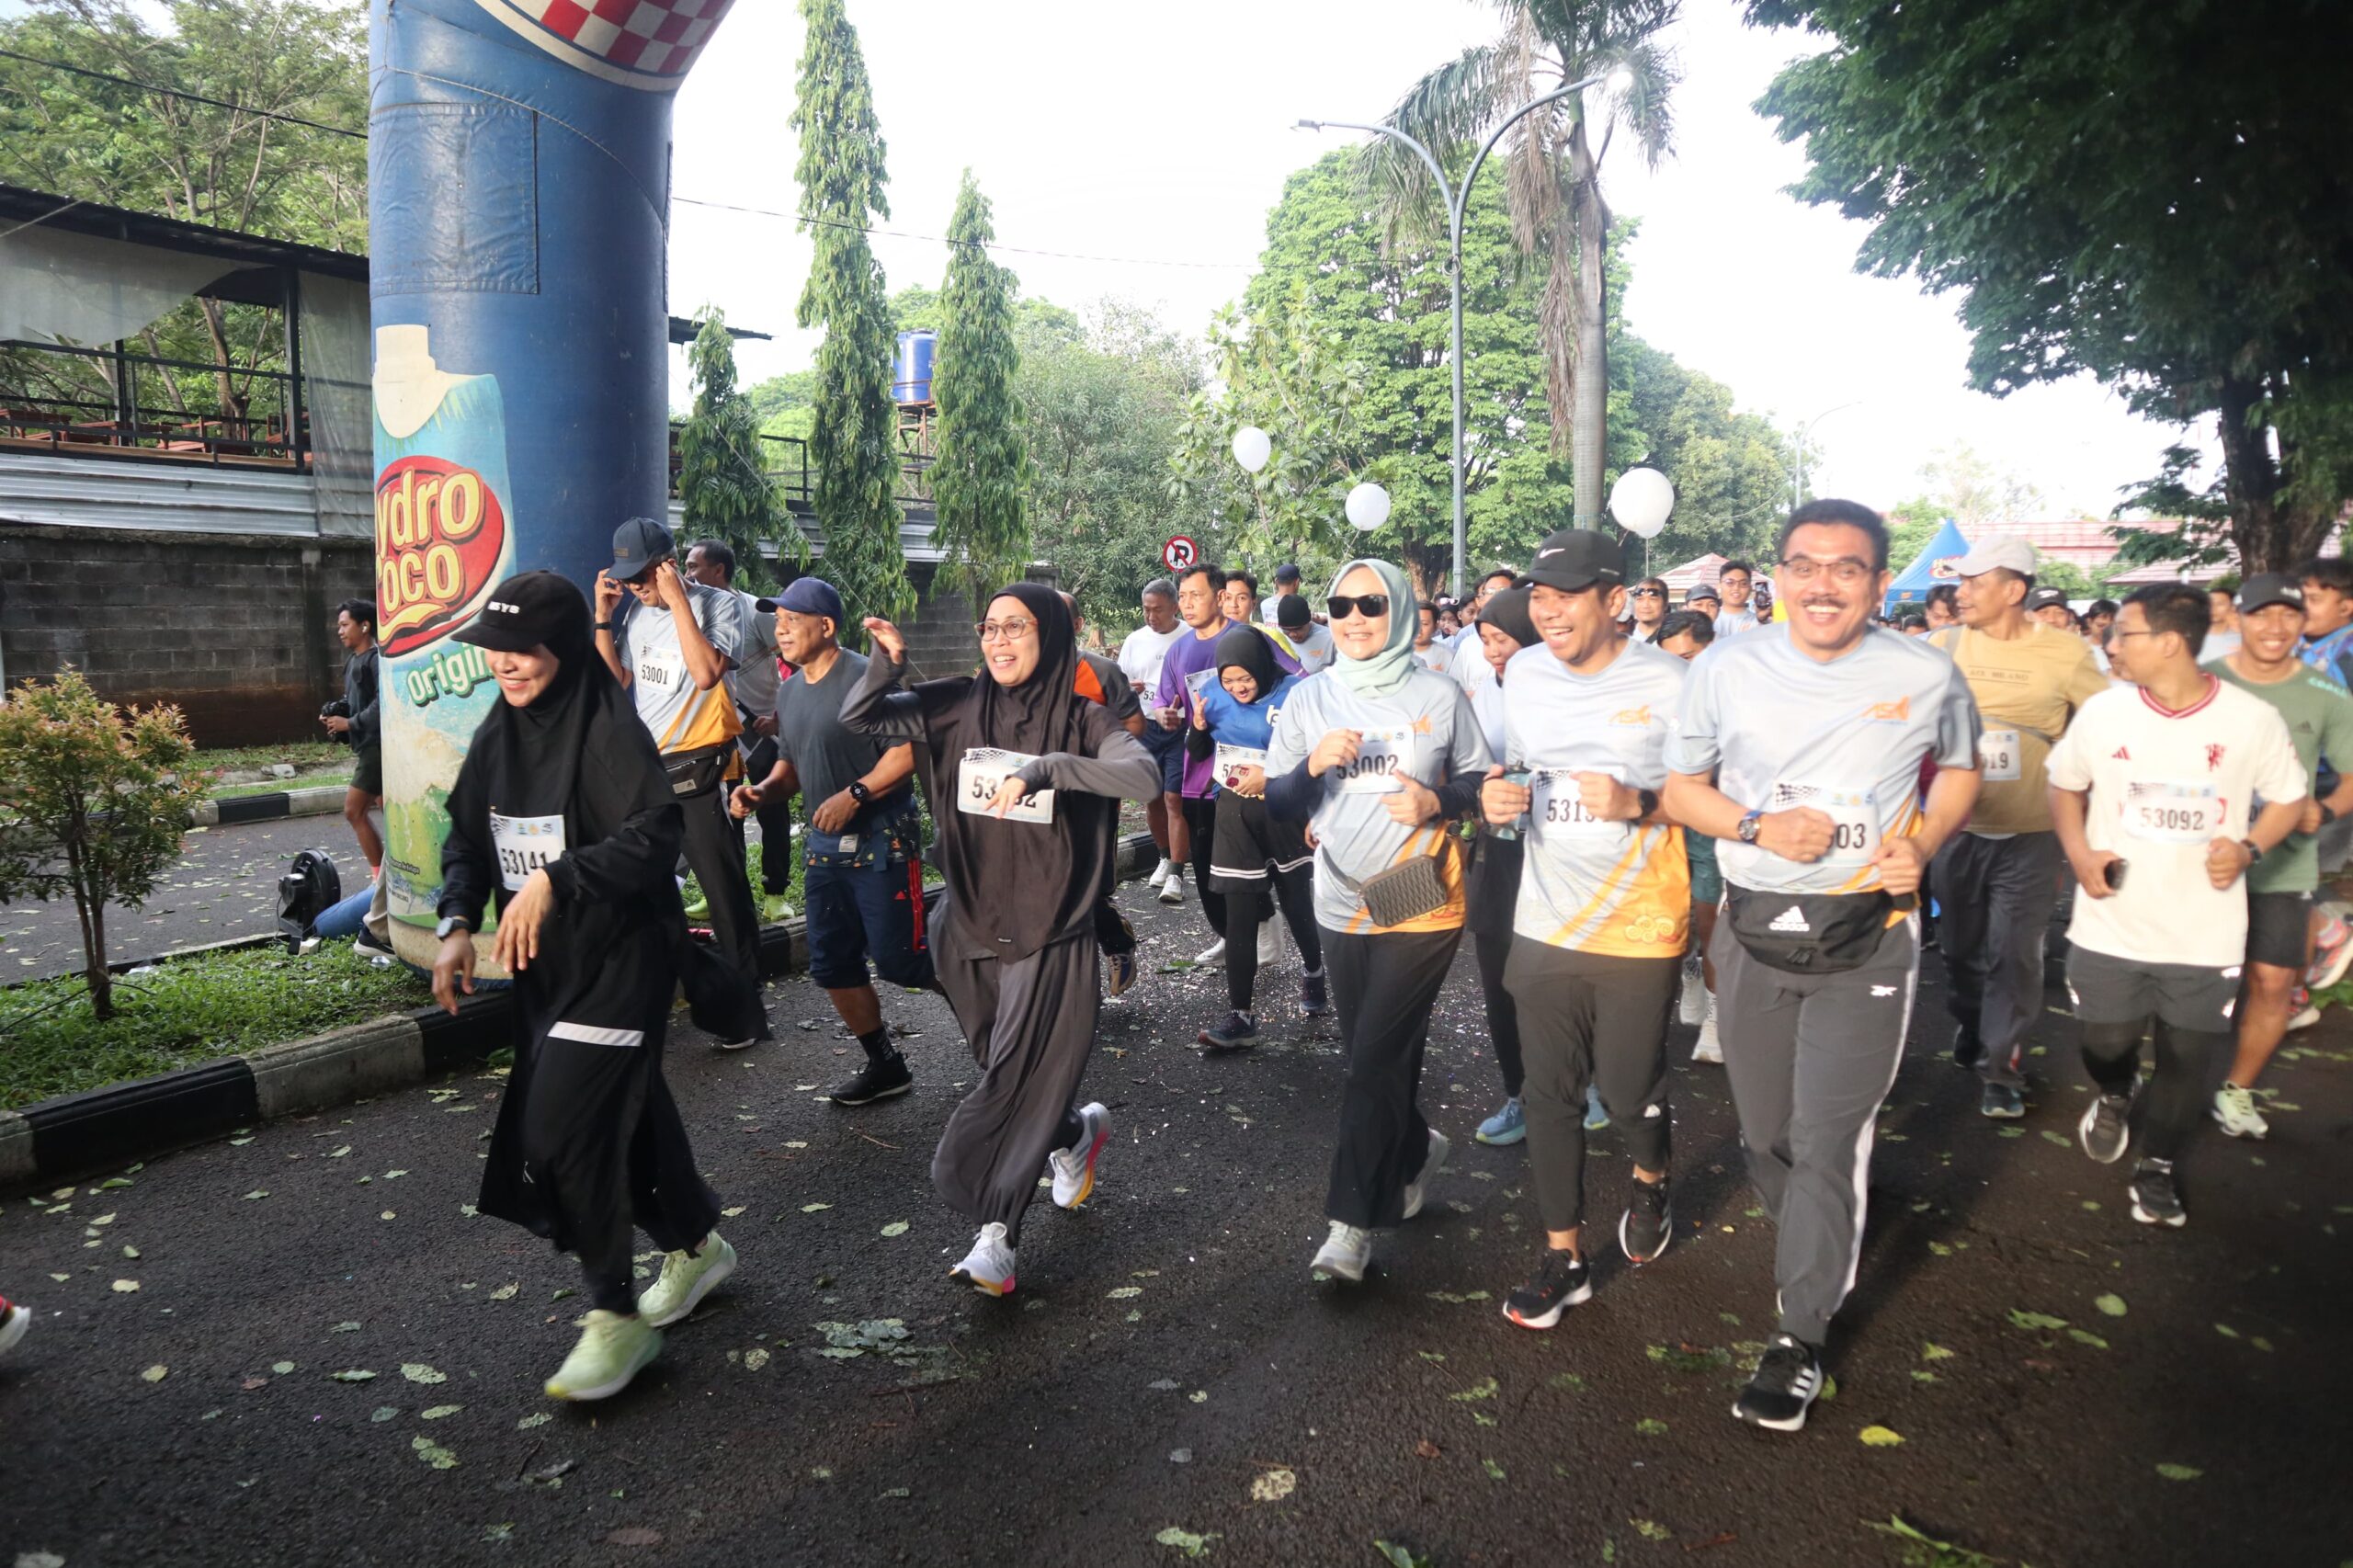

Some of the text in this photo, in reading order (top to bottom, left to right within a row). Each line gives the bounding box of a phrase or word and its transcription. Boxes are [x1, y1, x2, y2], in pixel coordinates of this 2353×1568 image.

[376, 470, 480, 559] ydro
[642, 665, 668, 685] 53001
[1336, 754, 1399, 780] 53002
[972, 775, 1037, 809] 532
[1546, 798, 1597, 824] 531
[2140, 807, 2205, 831] 53092
[1835, 823, 1867, 849] 03
[501, 847, 547, 876] 53141
[1768, 921, 1810, 932] adidas
